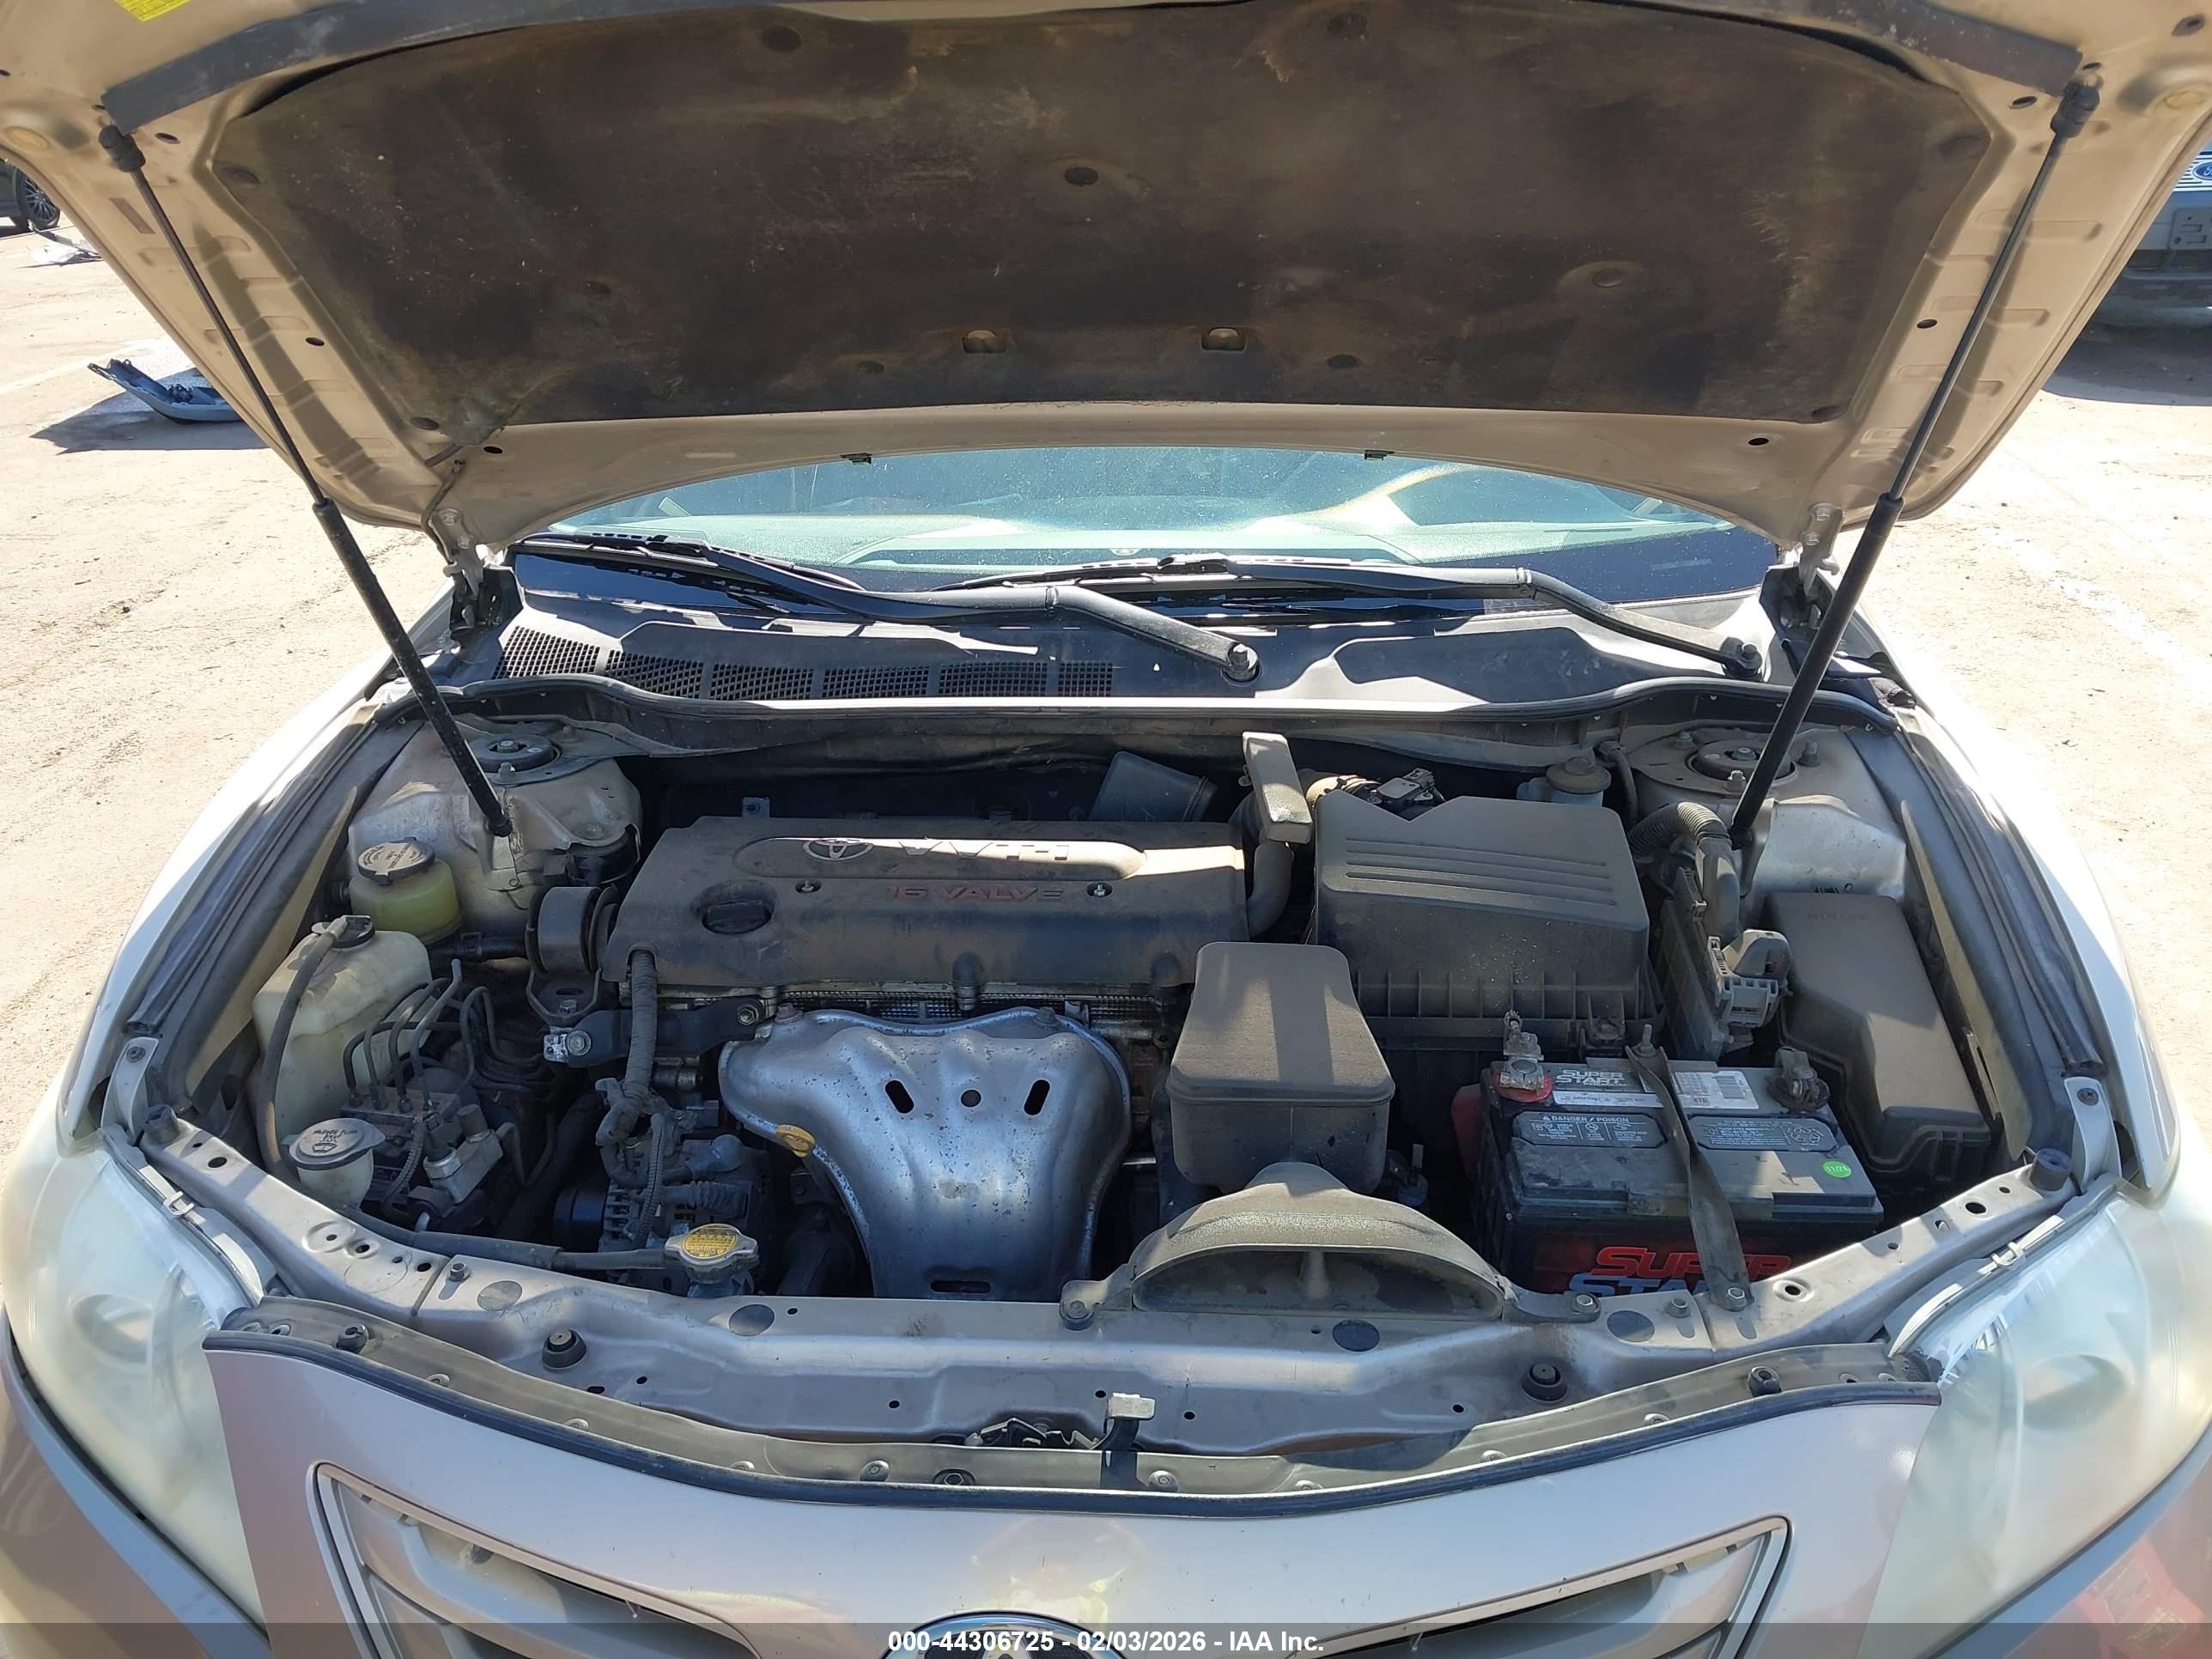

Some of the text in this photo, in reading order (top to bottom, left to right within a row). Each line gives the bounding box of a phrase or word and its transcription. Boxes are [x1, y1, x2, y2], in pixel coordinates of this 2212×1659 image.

[890, 885, 1066, 902] 16 VALVE
[1555, 1074, 1626, 1084] START
[1562, 1069, 1623, 1079] SUPER
[1591, 1246, 1792, 1280] SUPR
